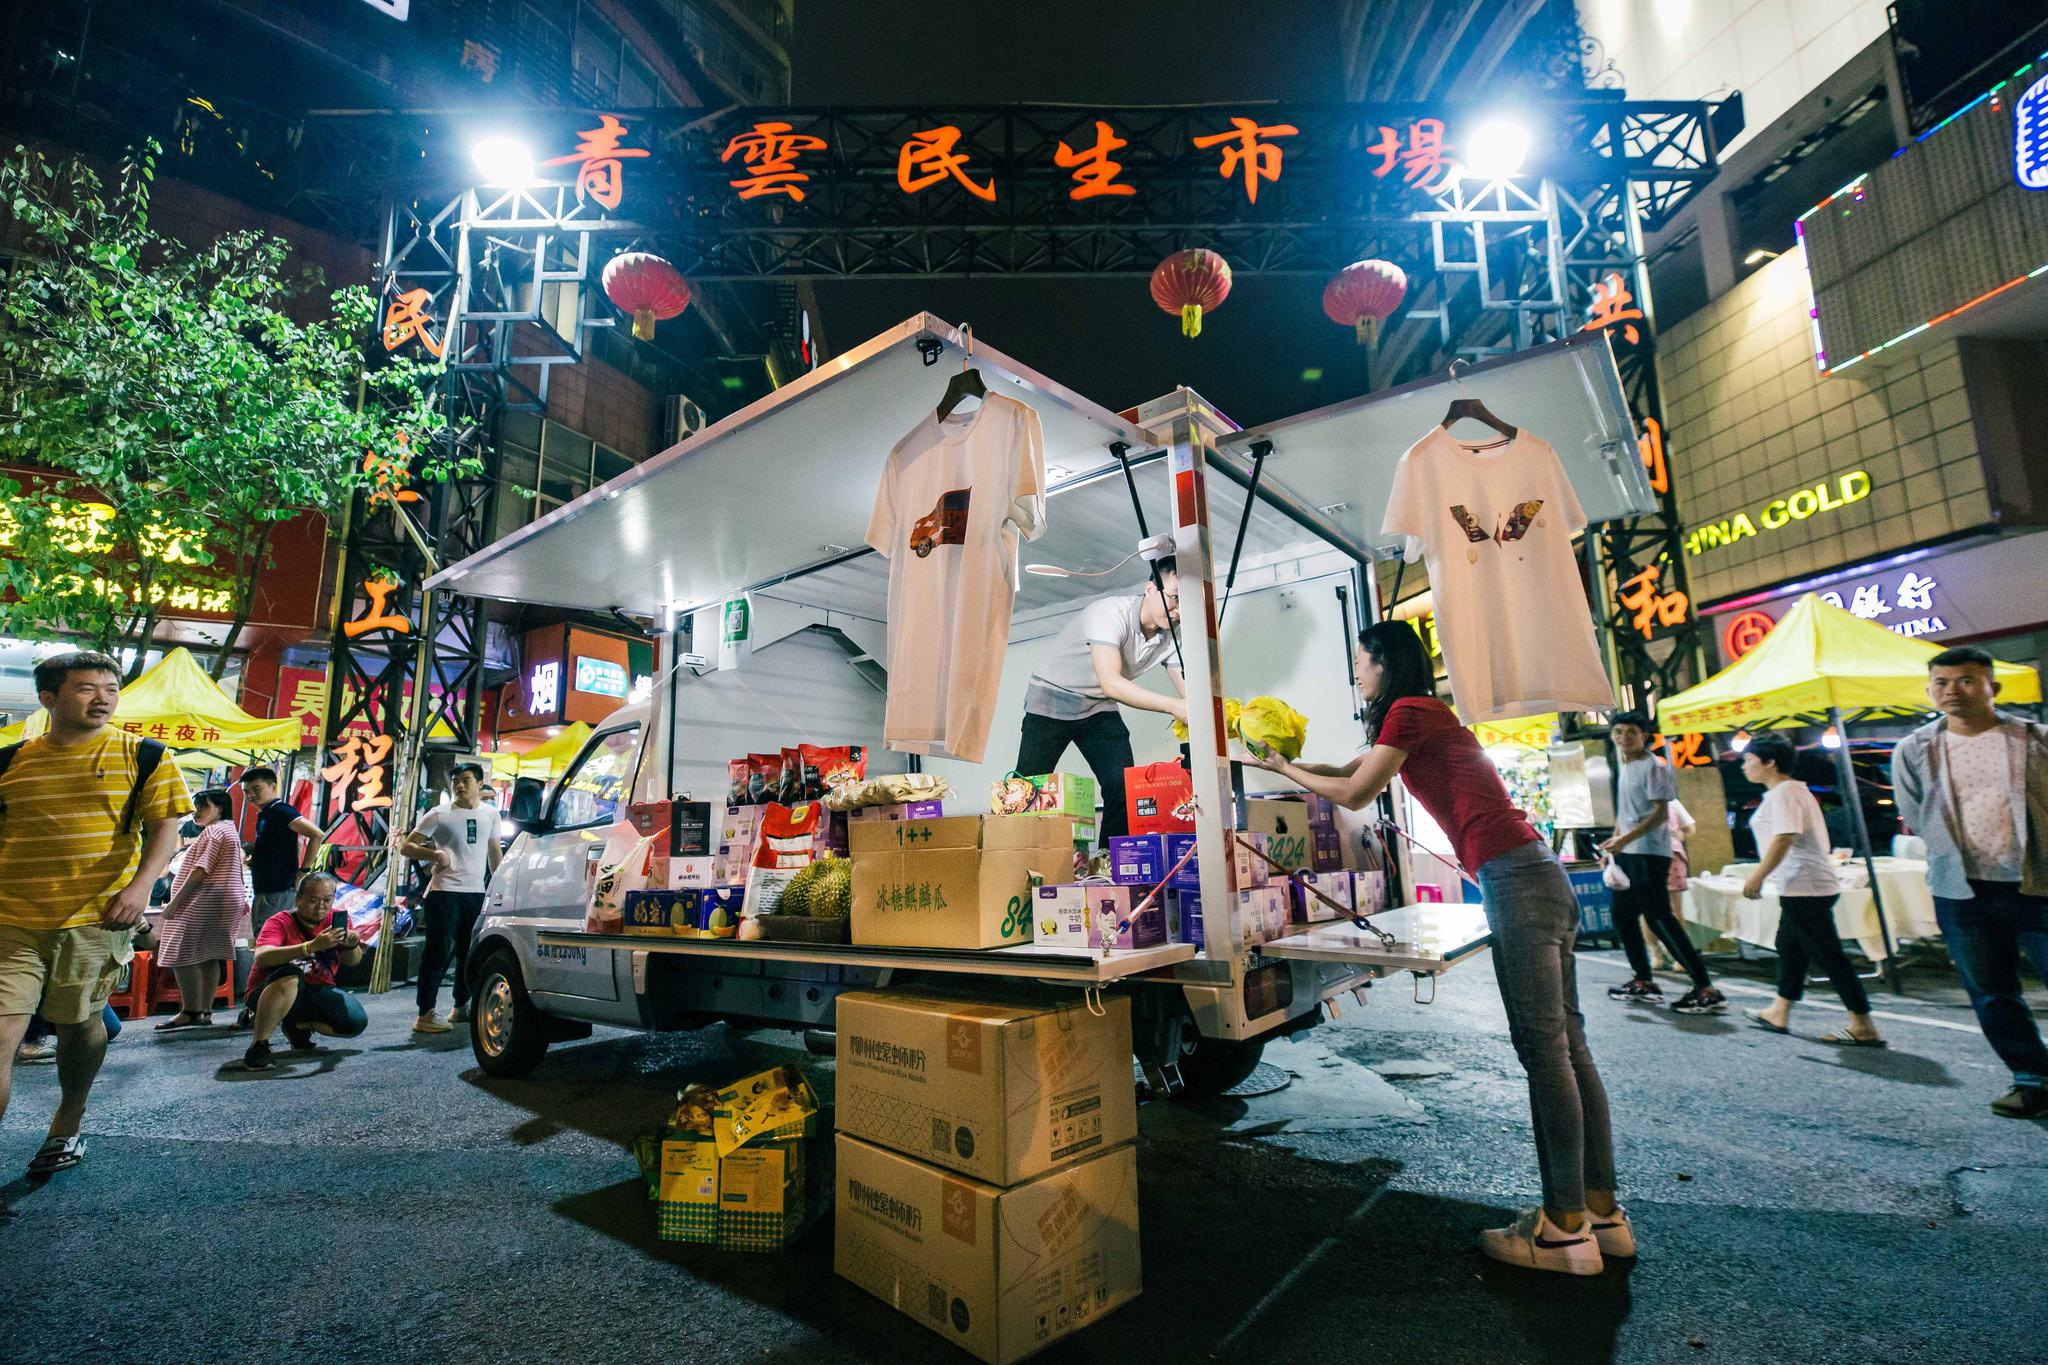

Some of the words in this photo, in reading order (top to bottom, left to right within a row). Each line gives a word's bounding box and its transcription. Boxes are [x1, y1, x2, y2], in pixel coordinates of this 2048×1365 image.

[541, 114, 1458, 210] 青雲民生市場
[1684, 512, 1758, 556] HINA
[1760, 470, 1872, 530] GOLD
[1792, 572, 1937, 618] 银行
[530, 662, 559, 716] 烟
[108, 721, 223, 743] 民生夜市
[896, 825, 933, 847] 1++
[849, 1034, 926, 1073] 柳州螺蛳粉
[848, 1178, 924, 1232] 柳州螺蛳粉
